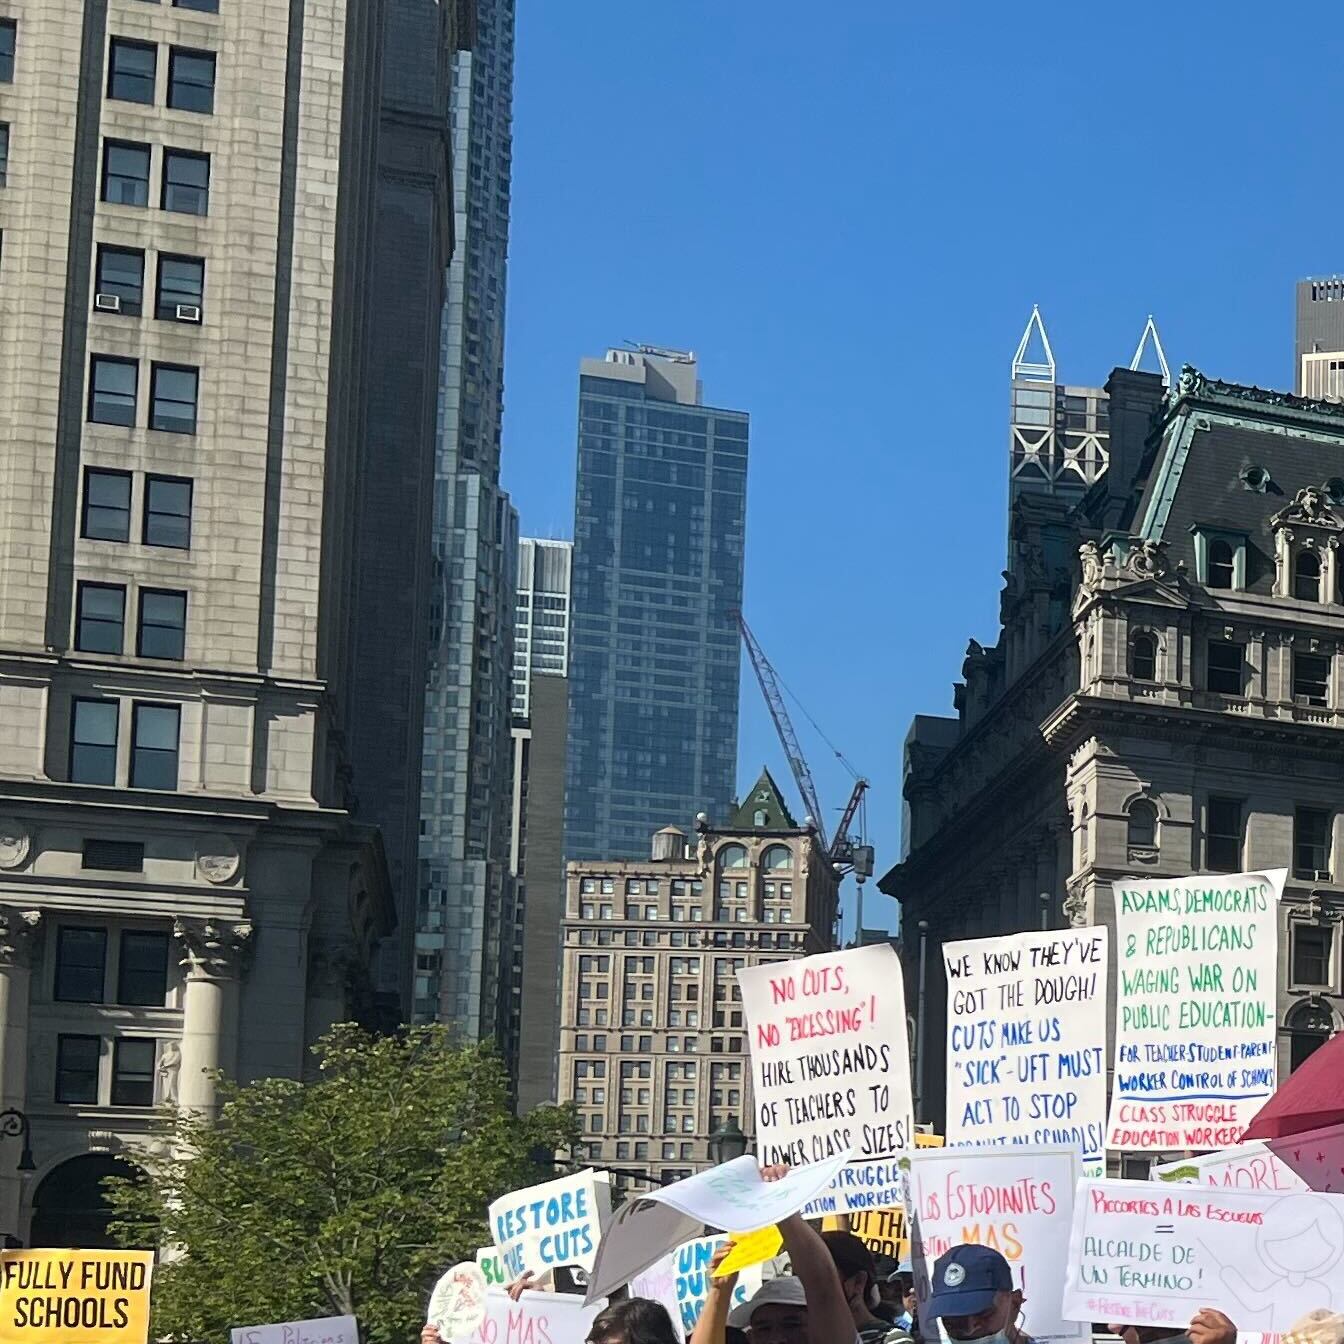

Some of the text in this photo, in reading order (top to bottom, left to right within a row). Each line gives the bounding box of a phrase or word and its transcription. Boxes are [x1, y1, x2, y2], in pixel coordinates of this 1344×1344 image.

[1184, 884, 1268, 913] DEMOCRATS
[1146, 924, 1256, 956] REPUBLICANS
[947, 937, 1103, 978] WE KNOW THEY'VE
[770, 966, 849, 1005] NO CUTS,
[954, 973, 1097, 1015] GOT THE DOUGH!
[1122, 963, 1257, 997] WAGING WAR ON
[1123, 1003, 1170, 1032] PUBLIC
[757, 1023, 780, 1049] NO
[952, 1016, 1061, 1052] CUTS MAKE US
[761, 1043, 891, 1088] HIRE THOUSANDS
[1058, 1047, 1103, 1080] MUST
[1120, 1044, 1140, 1063] FOR
[1118, 1072, 1166, 1092] WORKER
[1171, 1069, 1224, 1089] CONTROL
[1227, 1071, 1238, 1086] OF
[760, 1084, 890, 1128] OF TEACHERS TO
[962, 1092, 1077, 1127] ACT TO STOP
[1120, 1103, 1237, 1123] CLASS STRUGGLE
[861, 1114, 910, 1155] SIZES!
[1112, 1127, 1180, 1147] EDUCATION
[496, 1188, 587, 1243] RESTORE
[503, 1224, 593, 1276] THE CUTS
[1084, 1236, 1195, 1265] ALCALDE DE
[5, 1261, 146, 1290] FULLY FUND
[1081, 1265, 1108, 1285] UN
[13, 1297, 129, 1329] SCHOOLS
